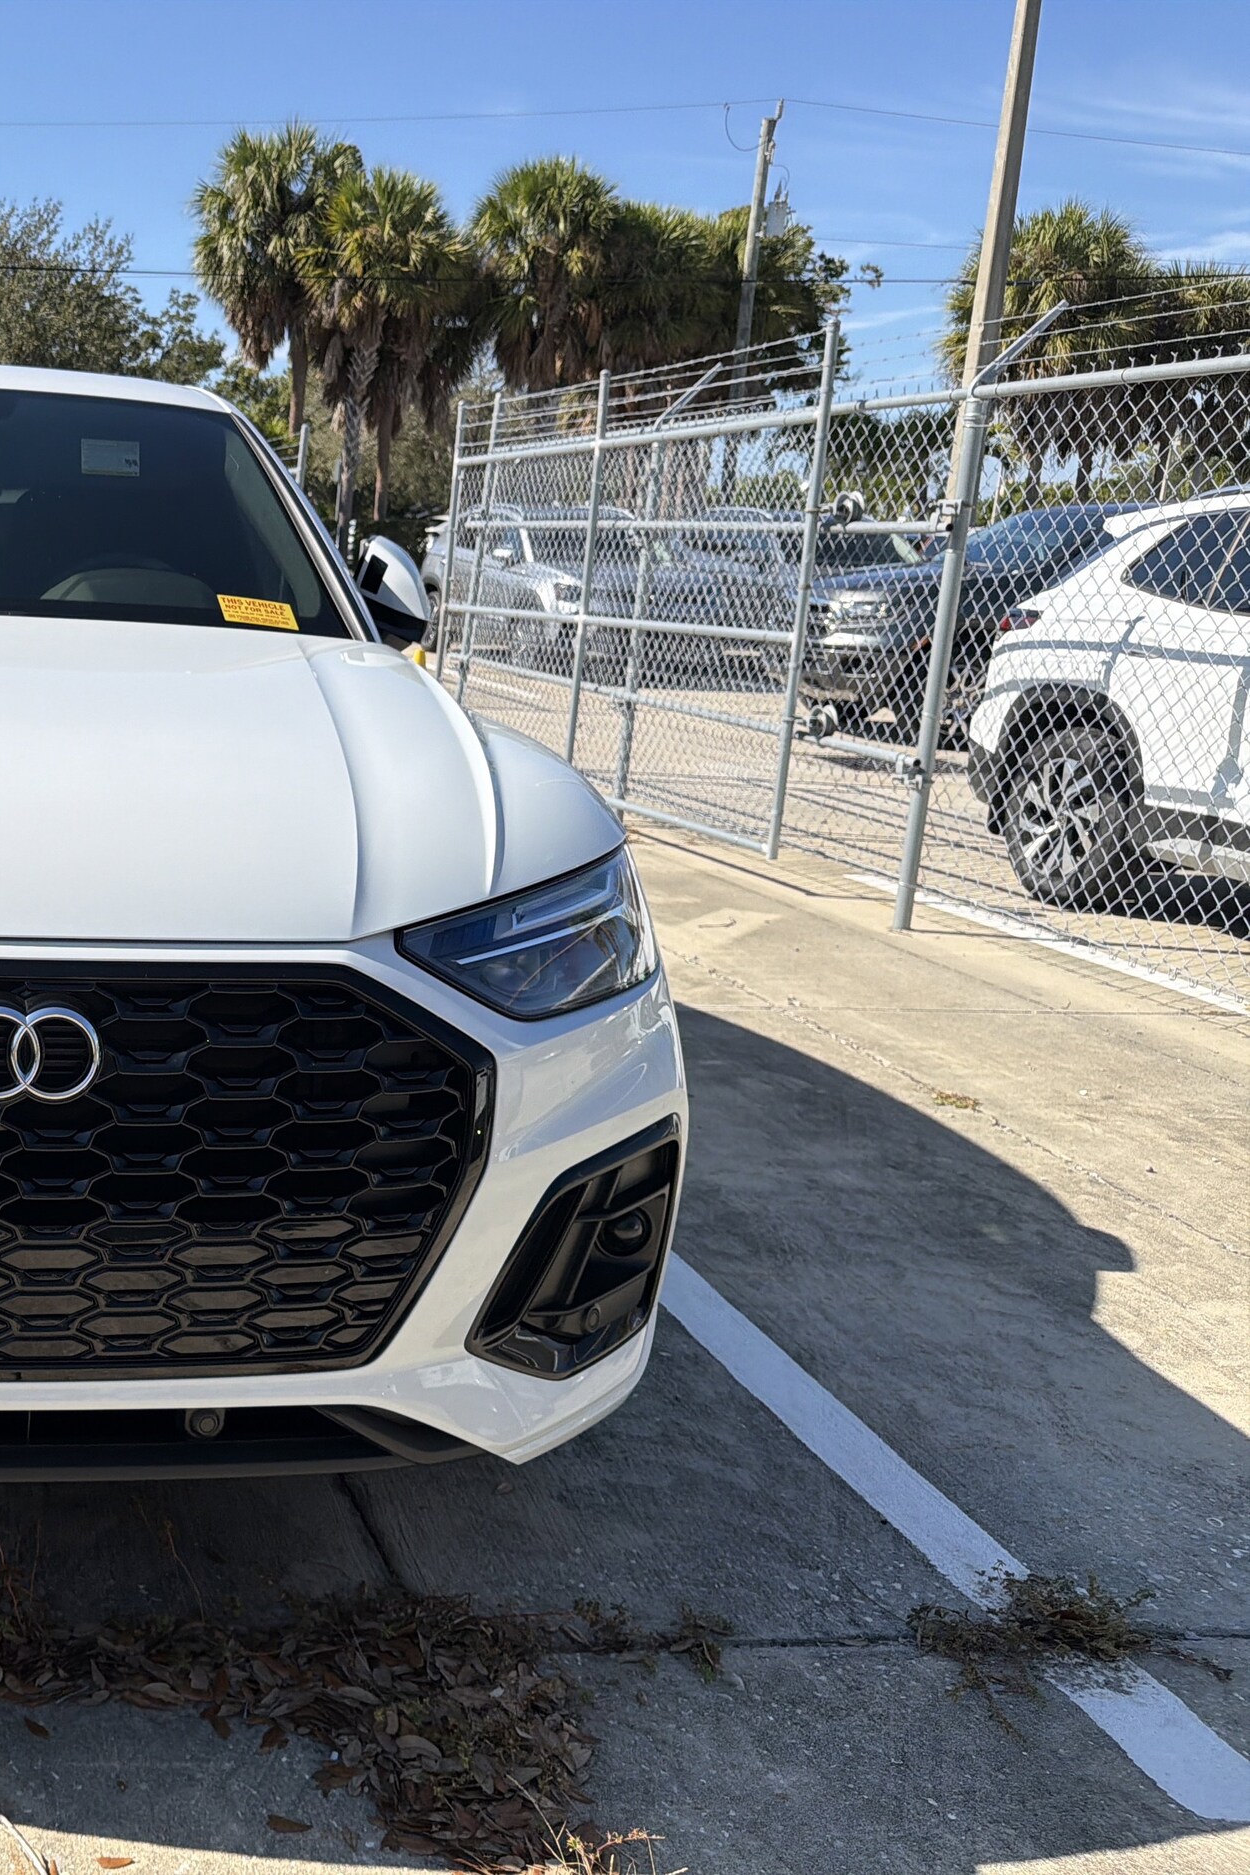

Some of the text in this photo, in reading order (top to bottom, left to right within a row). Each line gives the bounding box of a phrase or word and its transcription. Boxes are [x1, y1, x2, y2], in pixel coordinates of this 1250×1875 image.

[221, 597, 286, 612] THIS VEHICLE
[263, 608, 286, 616] SALE
